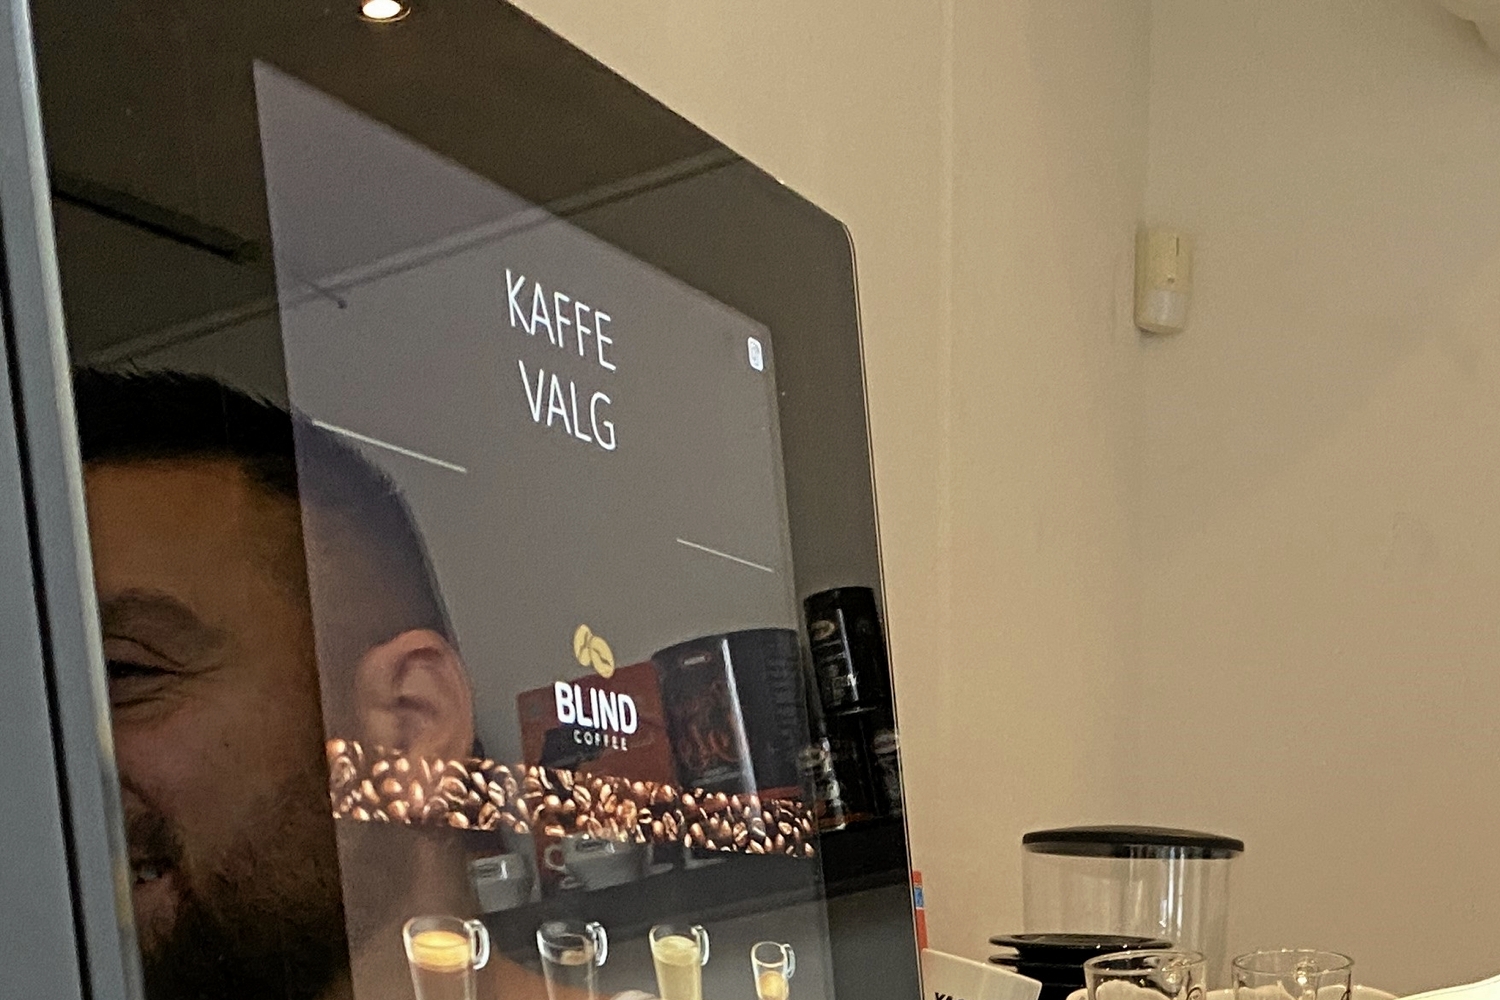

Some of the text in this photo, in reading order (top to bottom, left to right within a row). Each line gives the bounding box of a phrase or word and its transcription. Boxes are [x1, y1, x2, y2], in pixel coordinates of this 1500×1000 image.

[506, 268, 616, 371] KAFFE
[518, 360, 616, 450] VALG
[554, 681, 638, 735] BLIND
[573, 728, 628, 751] COFFEE
